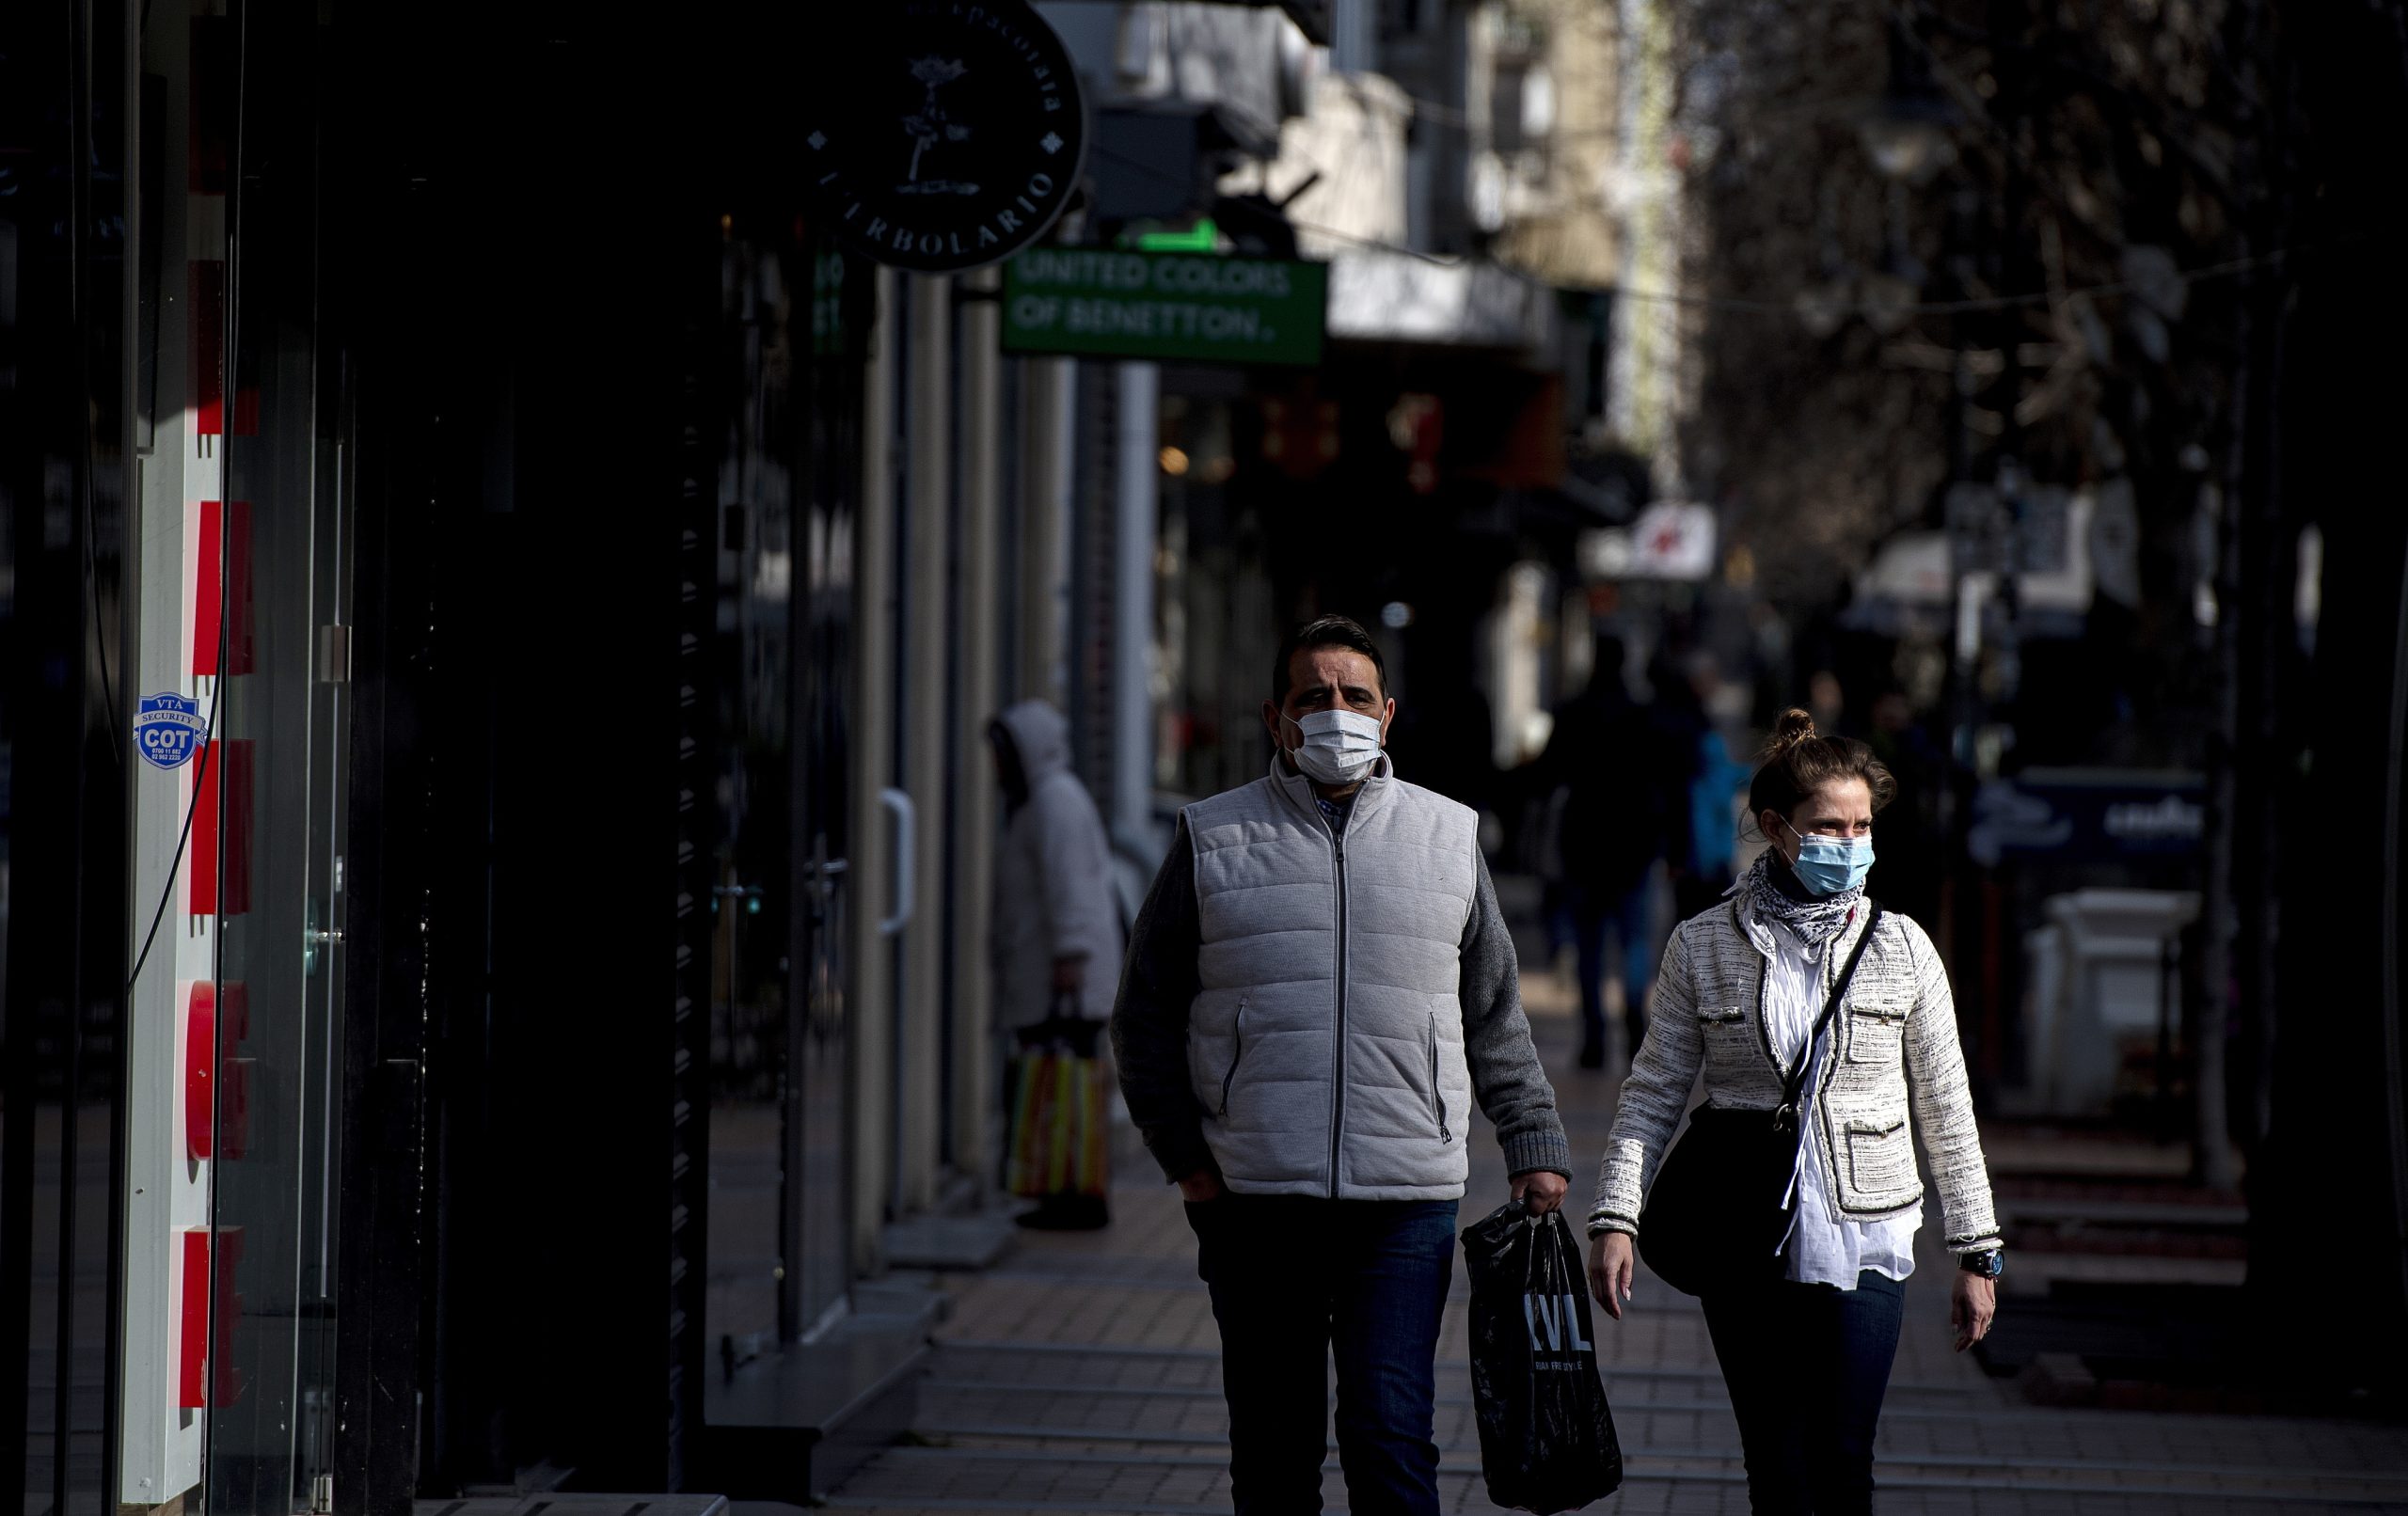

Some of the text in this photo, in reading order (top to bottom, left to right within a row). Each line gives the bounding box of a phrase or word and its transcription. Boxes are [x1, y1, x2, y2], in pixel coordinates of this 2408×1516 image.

[1016, 251, 1291, 297] UNITED COLORS
[1010, 293, 1060, 328] OF
[157, 699, 183, 709] VTA
[142, 712, 194, 724] SECURITY
